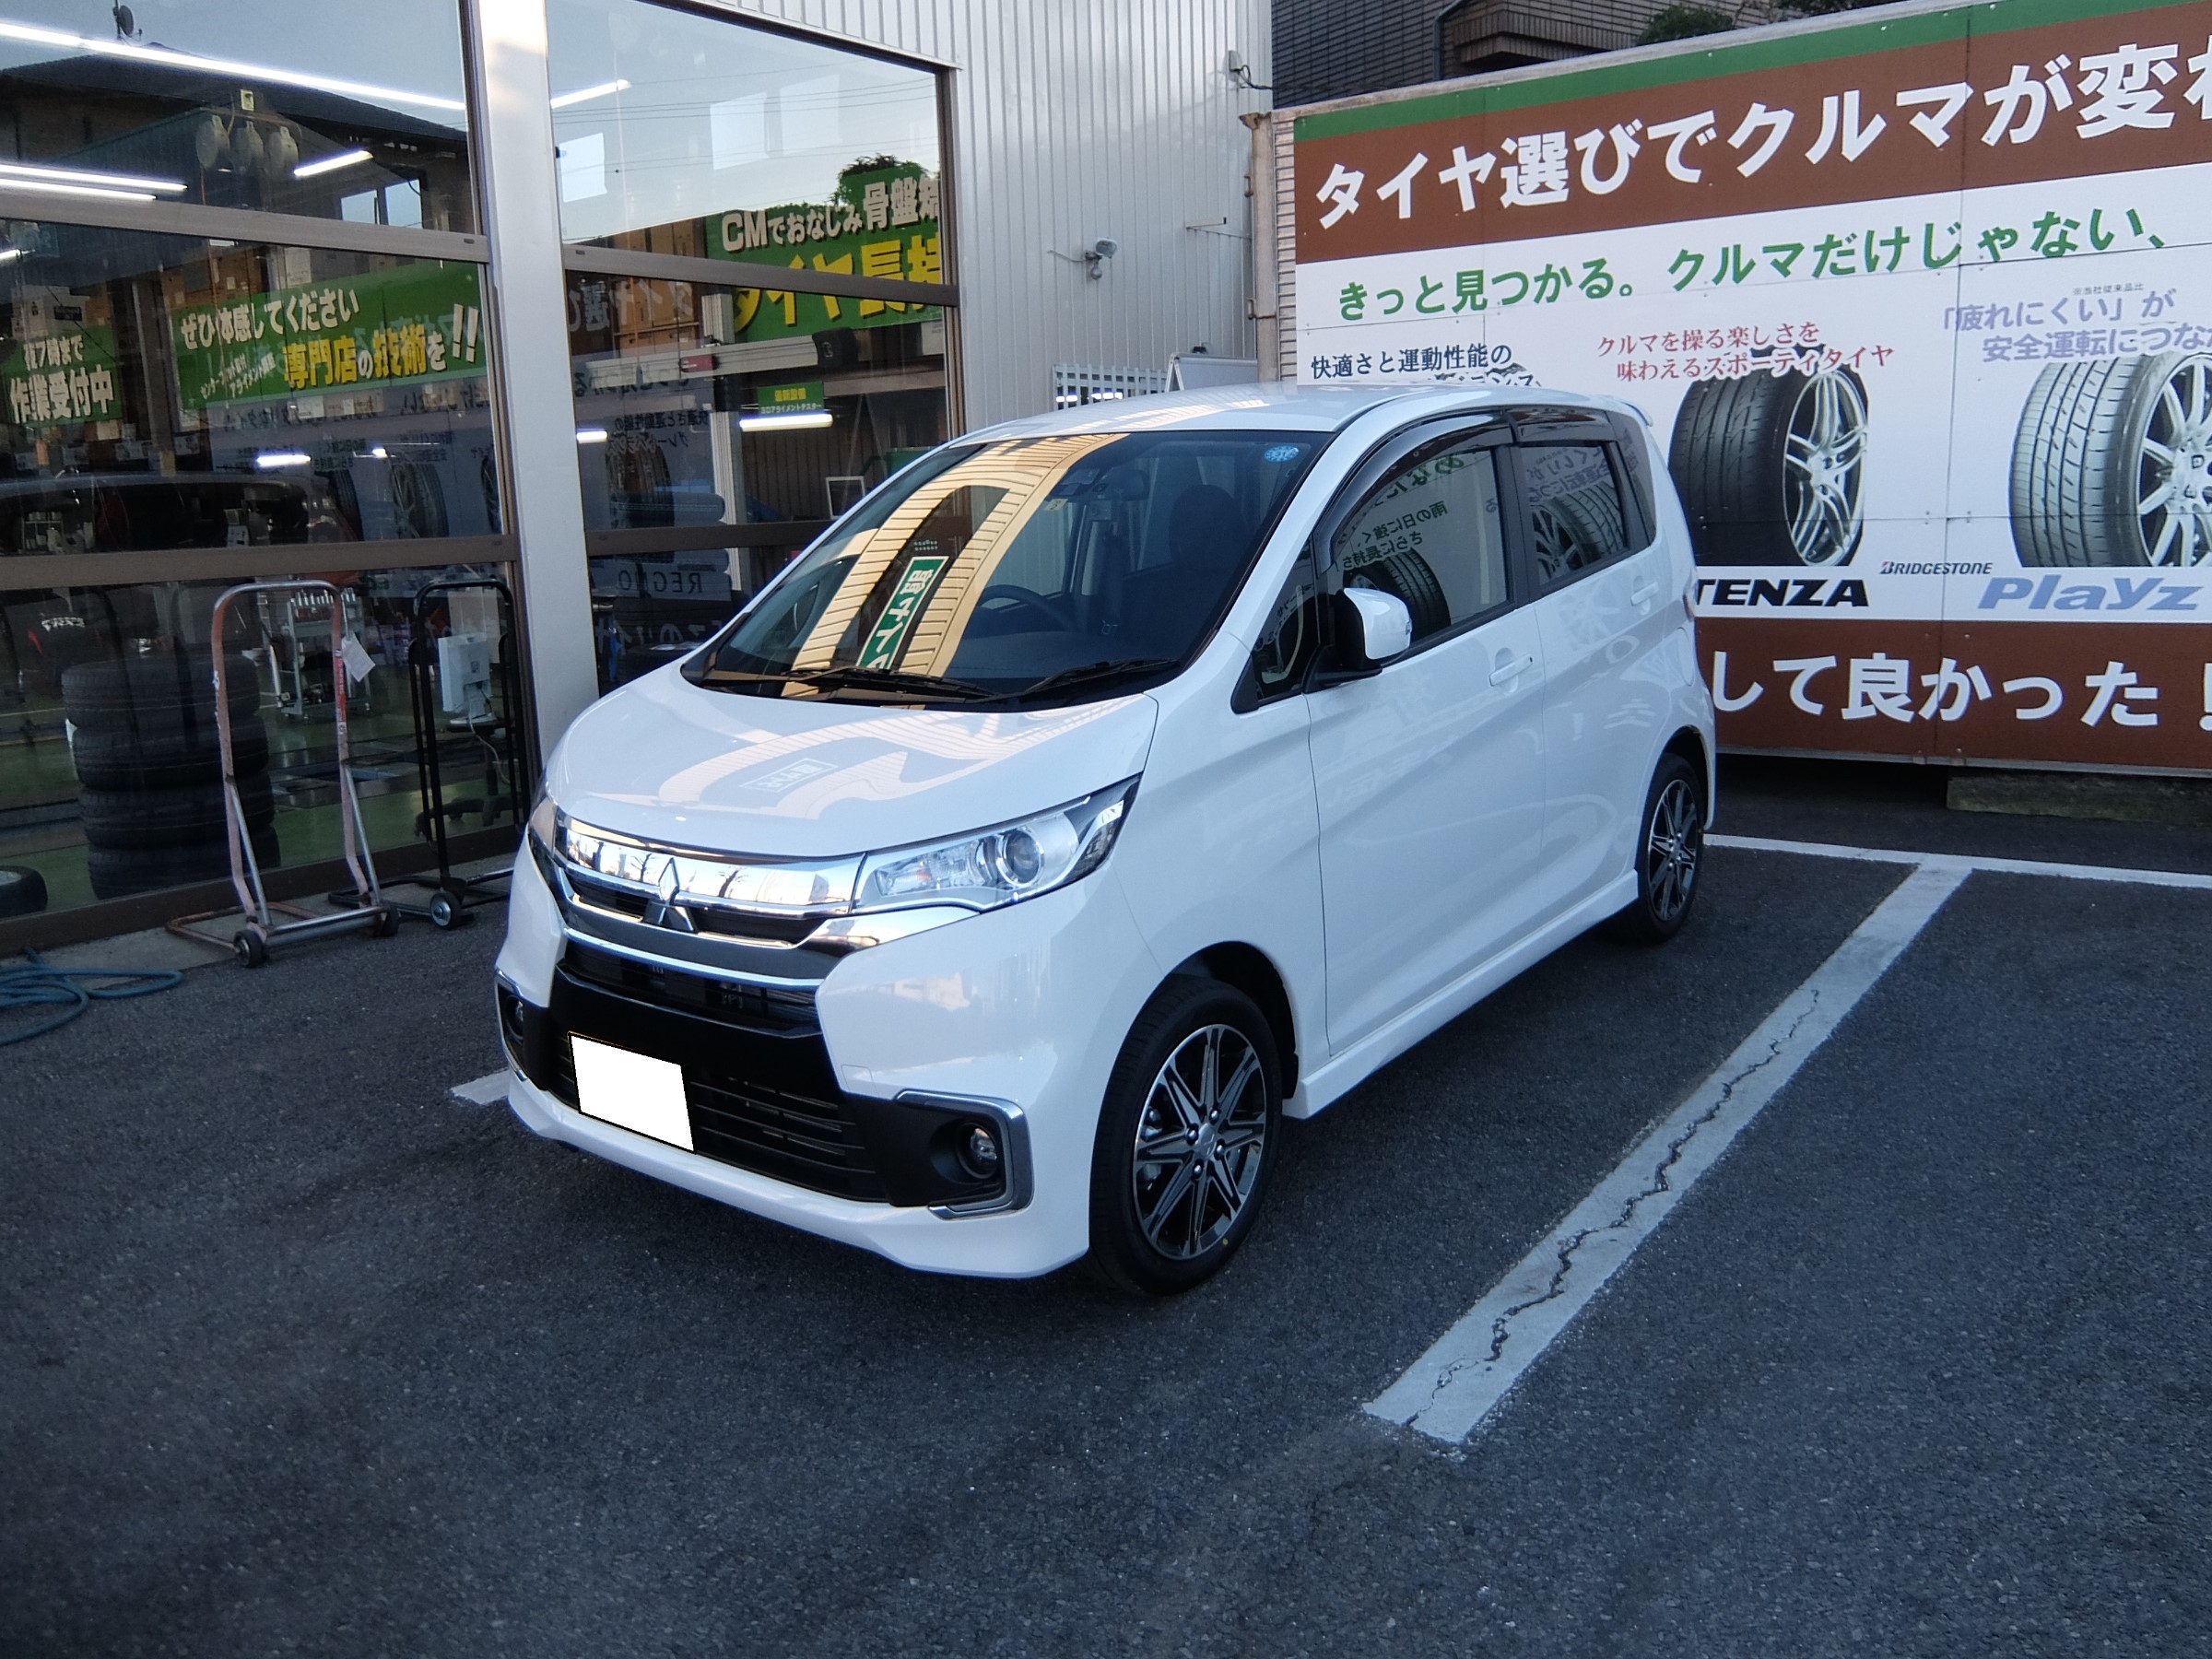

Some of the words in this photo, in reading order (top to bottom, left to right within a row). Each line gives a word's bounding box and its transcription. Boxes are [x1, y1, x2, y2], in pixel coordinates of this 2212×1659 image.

[1339, 257, 1632, 321] きっと見つかる。
[1667, 208, 2166, 291] クルマだけじゃない、
[1597, 322, 1820, 357] クルマを操る楽しさを
[1311, 343, 1512, 380] 快適さと運動性能の
[1617, 345, 1894, 382] 味わえるスポーティタイヤ
[10, 363, 114, 424] 作業受付中
[1880, 561, 1994, 575] BRIDGESTONE
[1978, 575, 2204, 611] Playz
